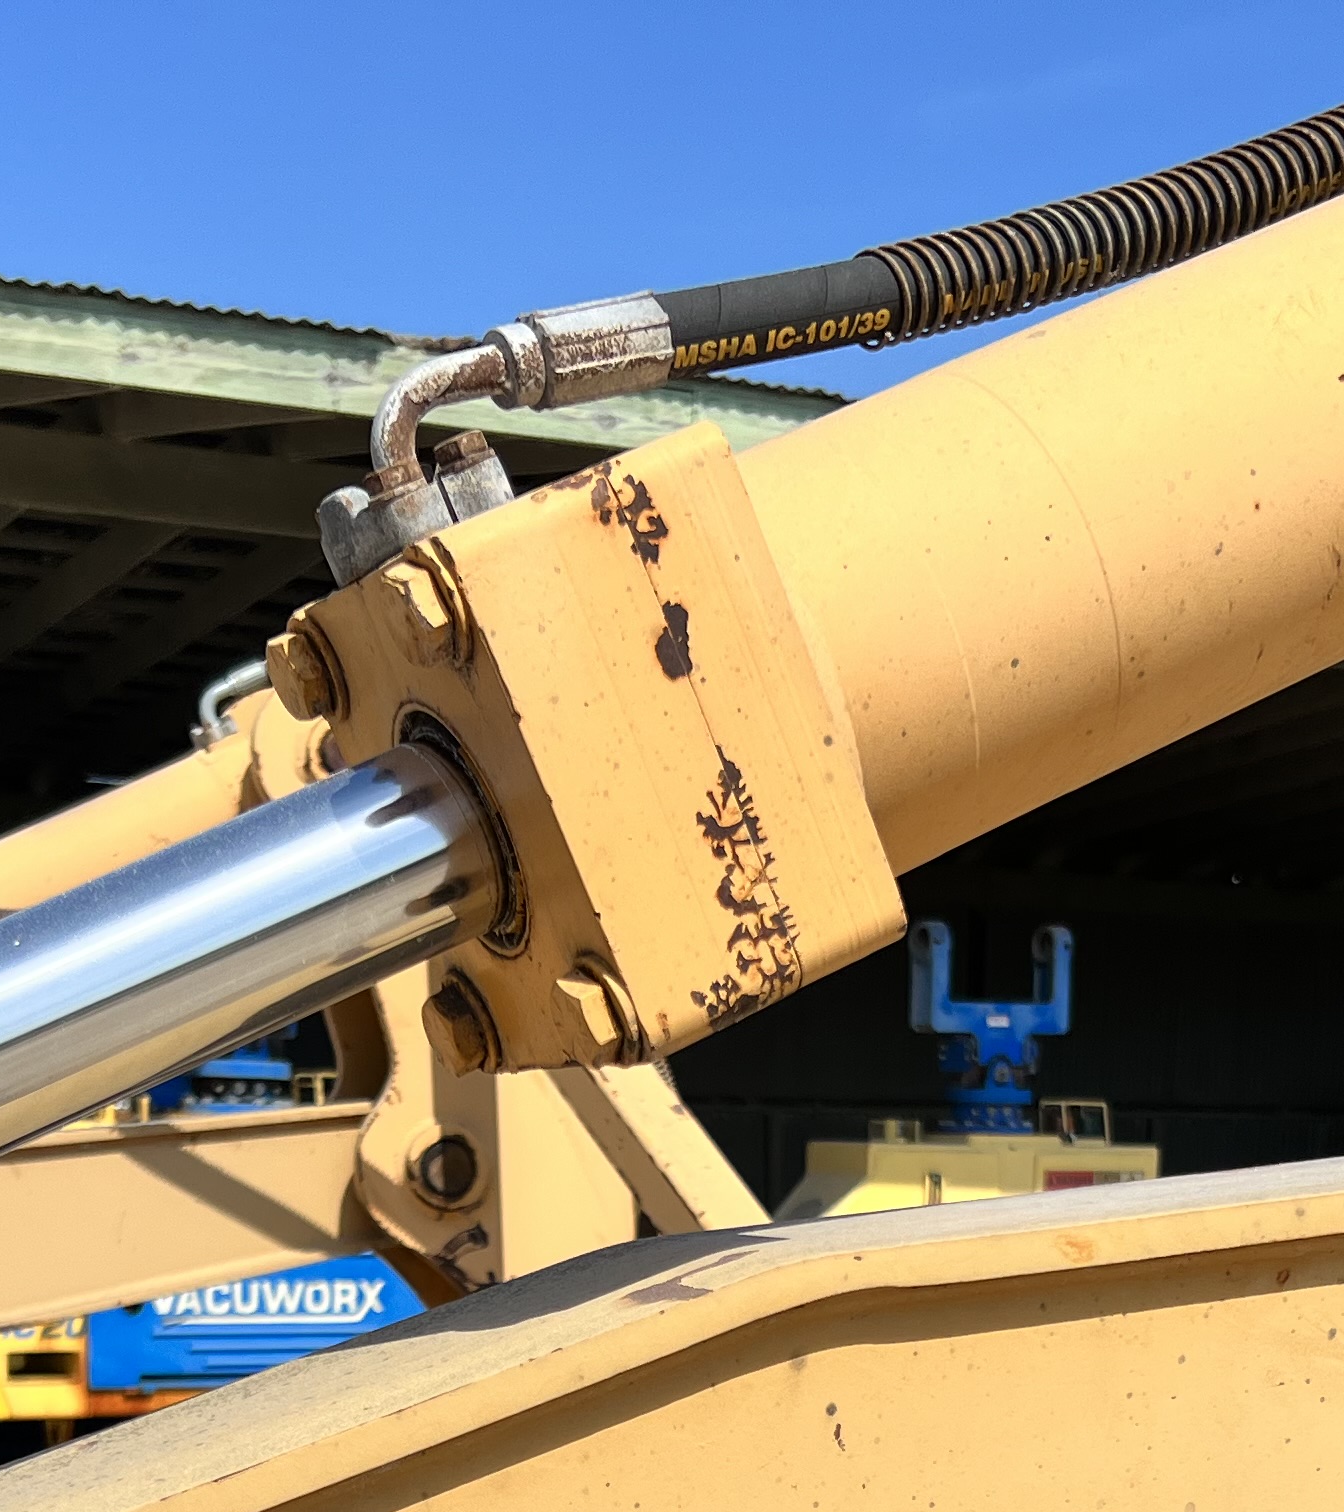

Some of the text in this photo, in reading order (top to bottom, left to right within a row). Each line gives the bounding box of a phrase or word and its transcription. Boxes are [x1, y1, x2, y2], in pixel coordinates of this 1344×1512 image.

[673, 334, 756, 369] MSHA
[766, 308, 892, 351] IC-101/39
[153, 1278, 386, 1316] VACUWORX
